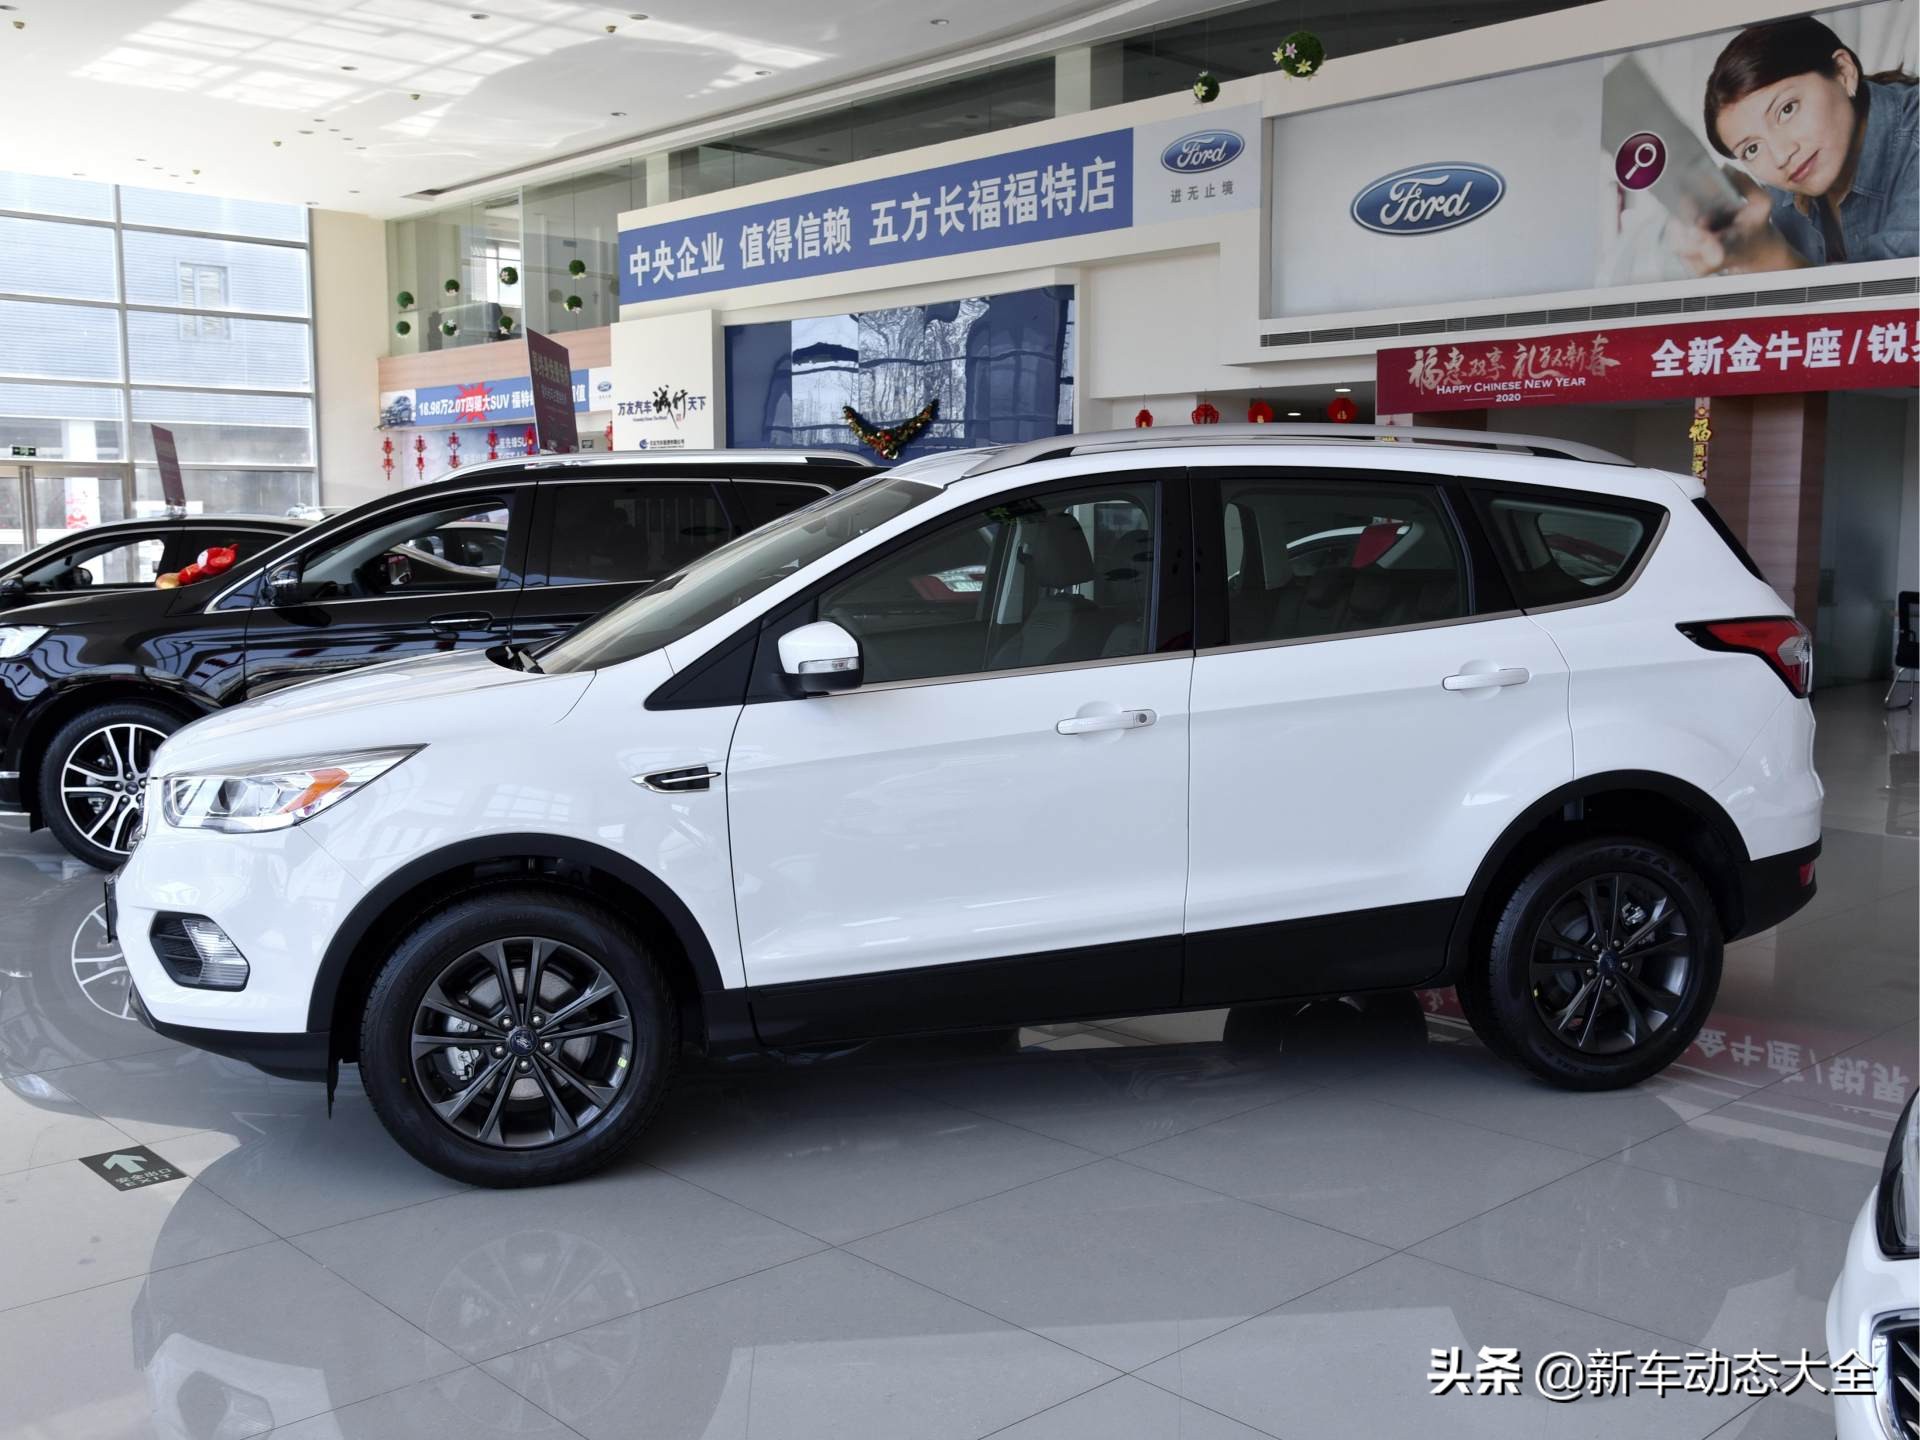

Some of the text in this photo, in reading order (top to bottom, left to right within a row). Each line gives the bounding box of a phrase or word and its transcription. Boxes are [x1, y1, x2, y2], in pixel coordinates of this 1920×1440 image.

[1177, 137, 1228, 168] Ford
[1170, 180, 1234, 203] 进无止境
[1380, 175, 1473, 225] Ford
[630, 156, 1116, 287] 中央企业 值得信赖 五方长福福特店
[1436, 376, 1587, 395] HAPPY CHINESE NEW YEAR
[1495, 393, 1521, 402] 2020
[115, 1168, 172, 1184] 安全出口
[125, 1174, 171, 1187] EXIT
